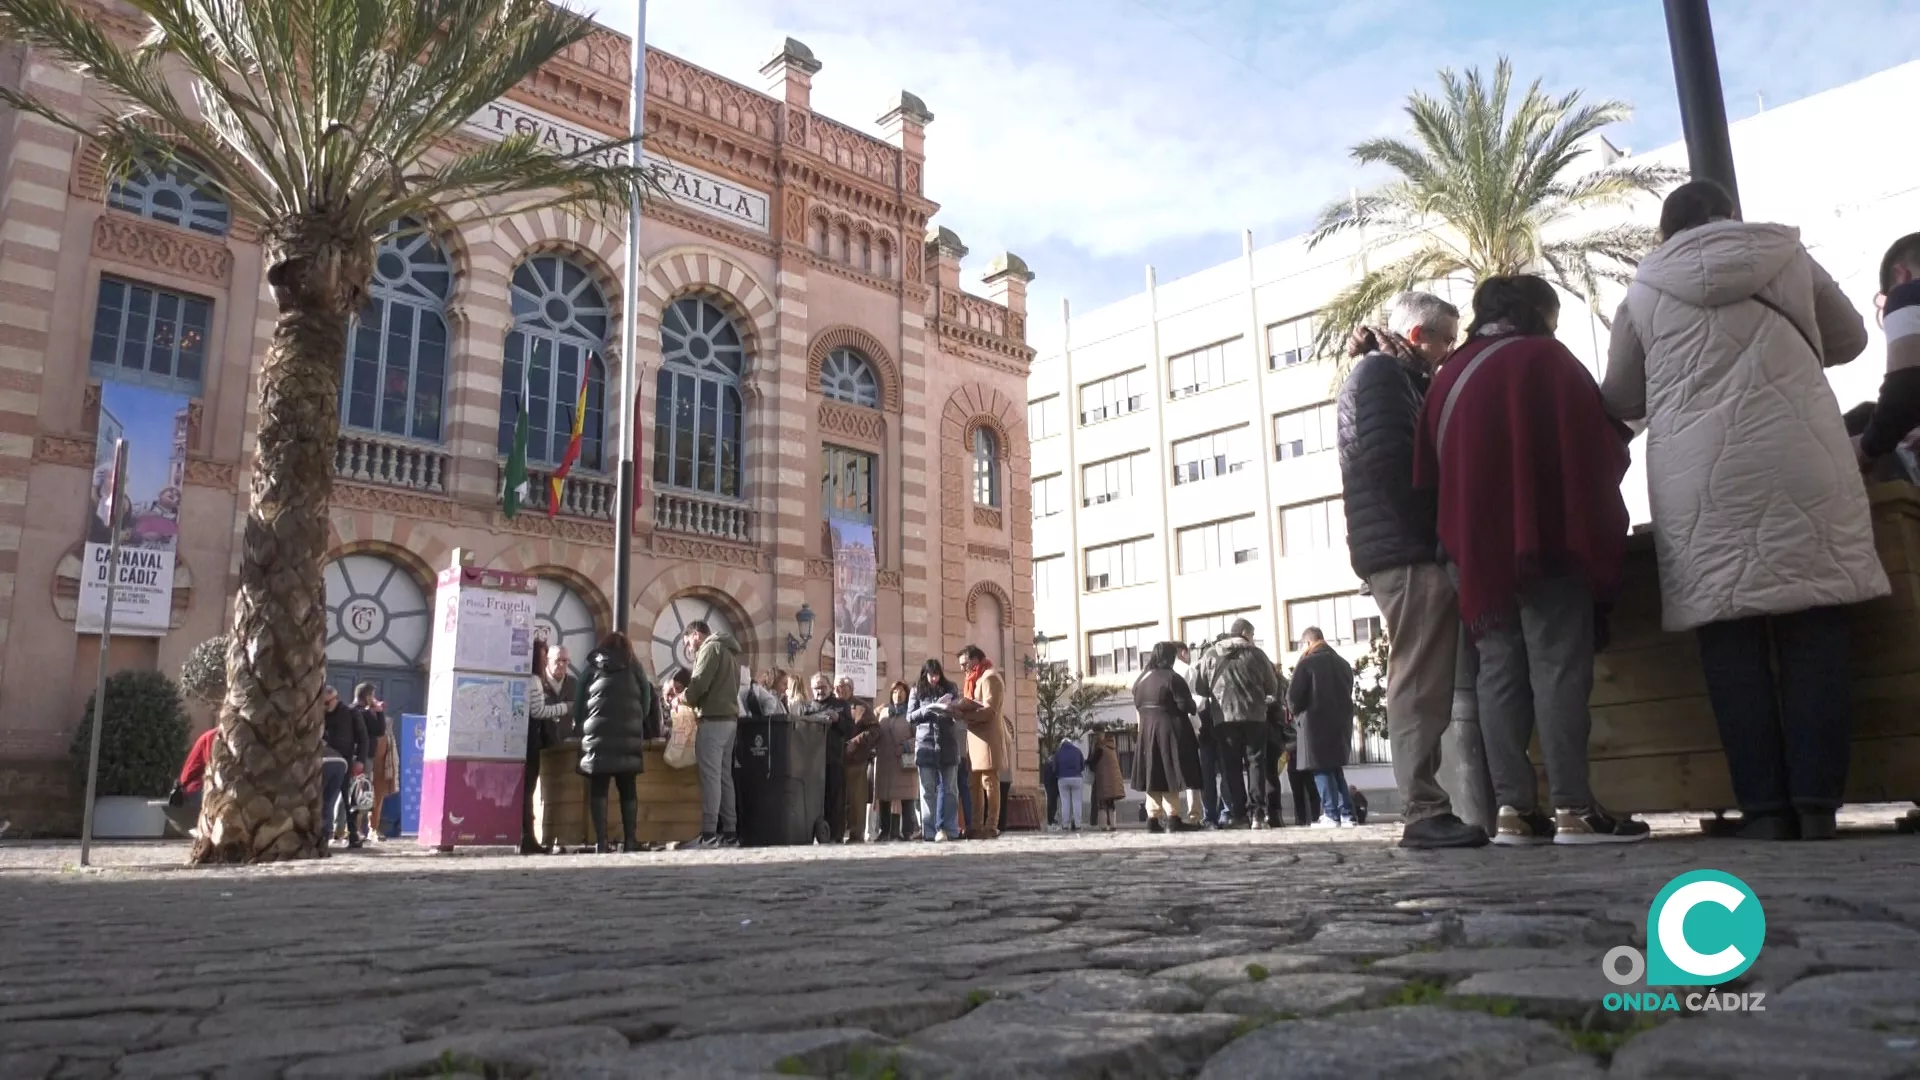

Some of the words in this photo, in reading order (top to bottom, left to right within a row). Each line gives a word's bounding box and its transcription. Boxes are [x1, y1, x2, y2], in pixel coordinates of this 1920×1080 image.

[649, 163, 753, 218] FALLA
[119, 567, 158, 586] CÁDIZ
[839, 636, 871, 650] CARNAVAL
